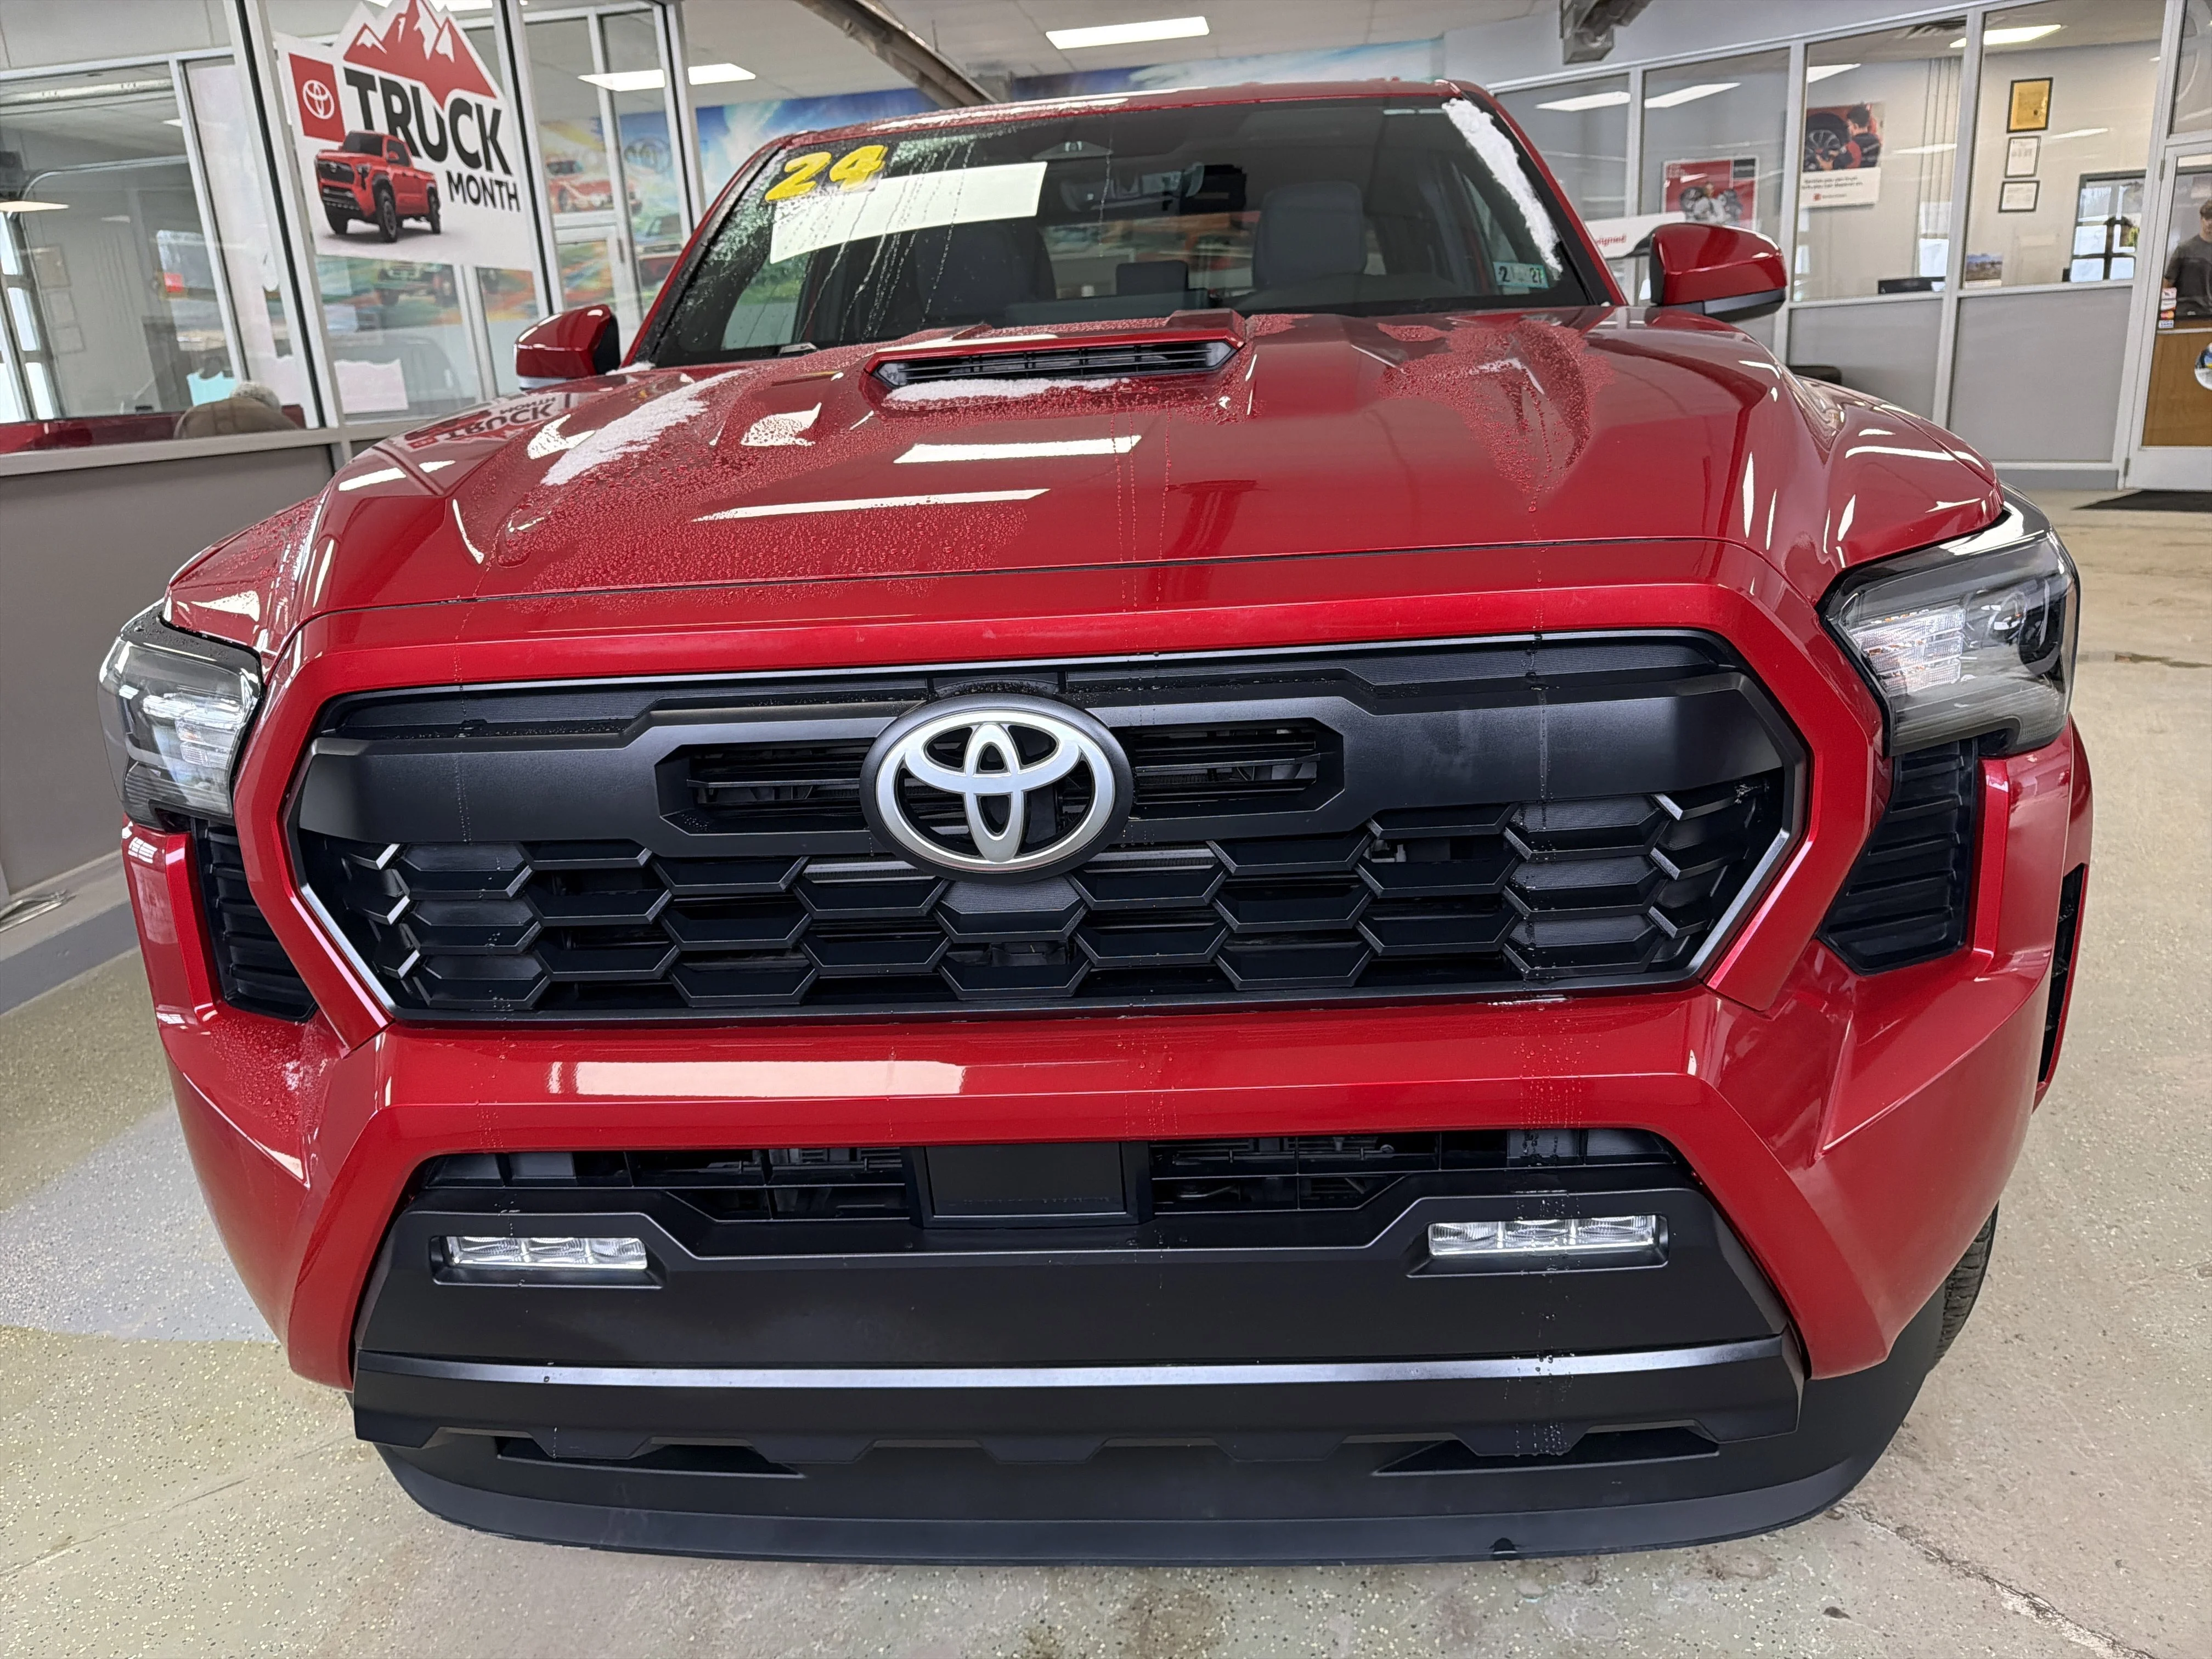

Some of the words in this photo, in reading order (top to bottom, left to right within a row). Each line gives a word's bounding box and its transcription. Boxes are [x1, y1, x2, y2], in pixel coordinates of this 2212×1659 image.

[343, 66, 513, 176] TRUCK
[446, 170, 520, 212] MONTH
[765, 145, 888, 202] 24
